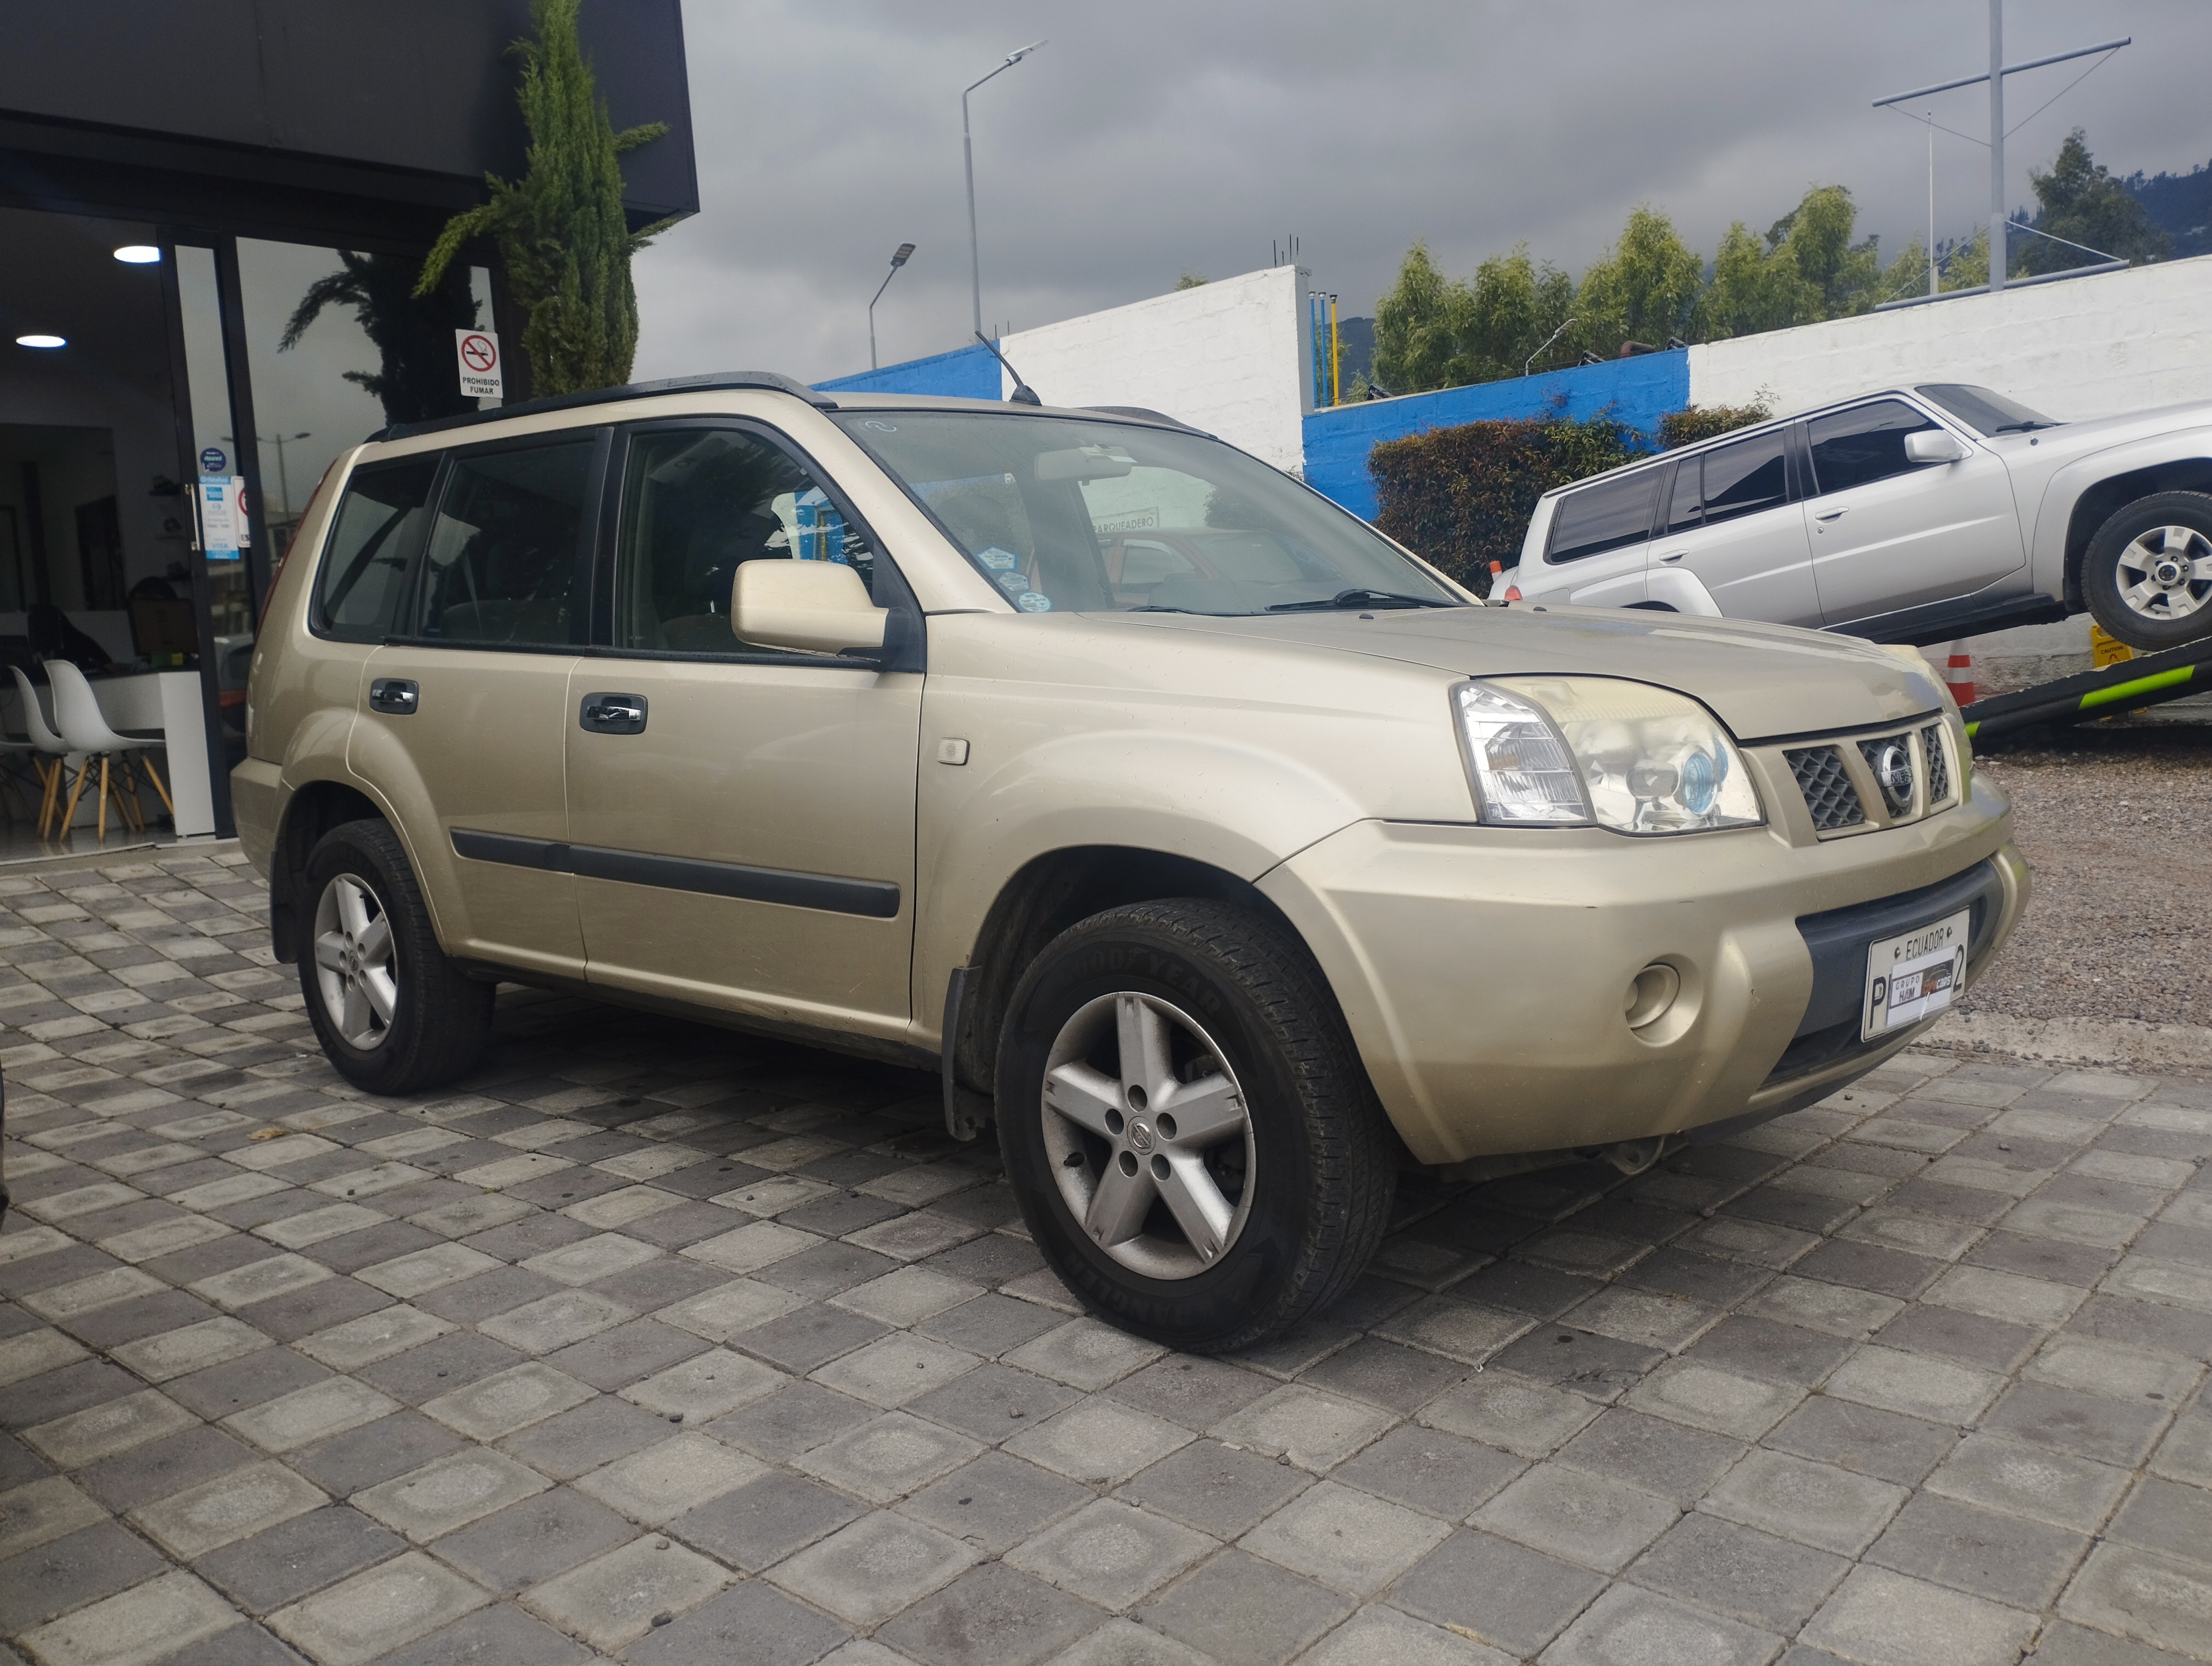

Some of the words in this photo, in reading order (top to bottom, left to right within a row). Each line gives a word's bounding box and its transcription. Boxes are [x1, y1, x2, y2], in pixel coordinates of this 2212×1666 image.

[462, 376, 499, 386] PROHIBIDO
[470, 386, 494, 395] FUMAR
[1092, 516, 1154, 533] PARQUEADERO
[2100, 645, 2124, 655] CAUTION
[1906, 927, 1944, 959] ECUADOR
[1895, 975, 1920, 990] GRUPO
